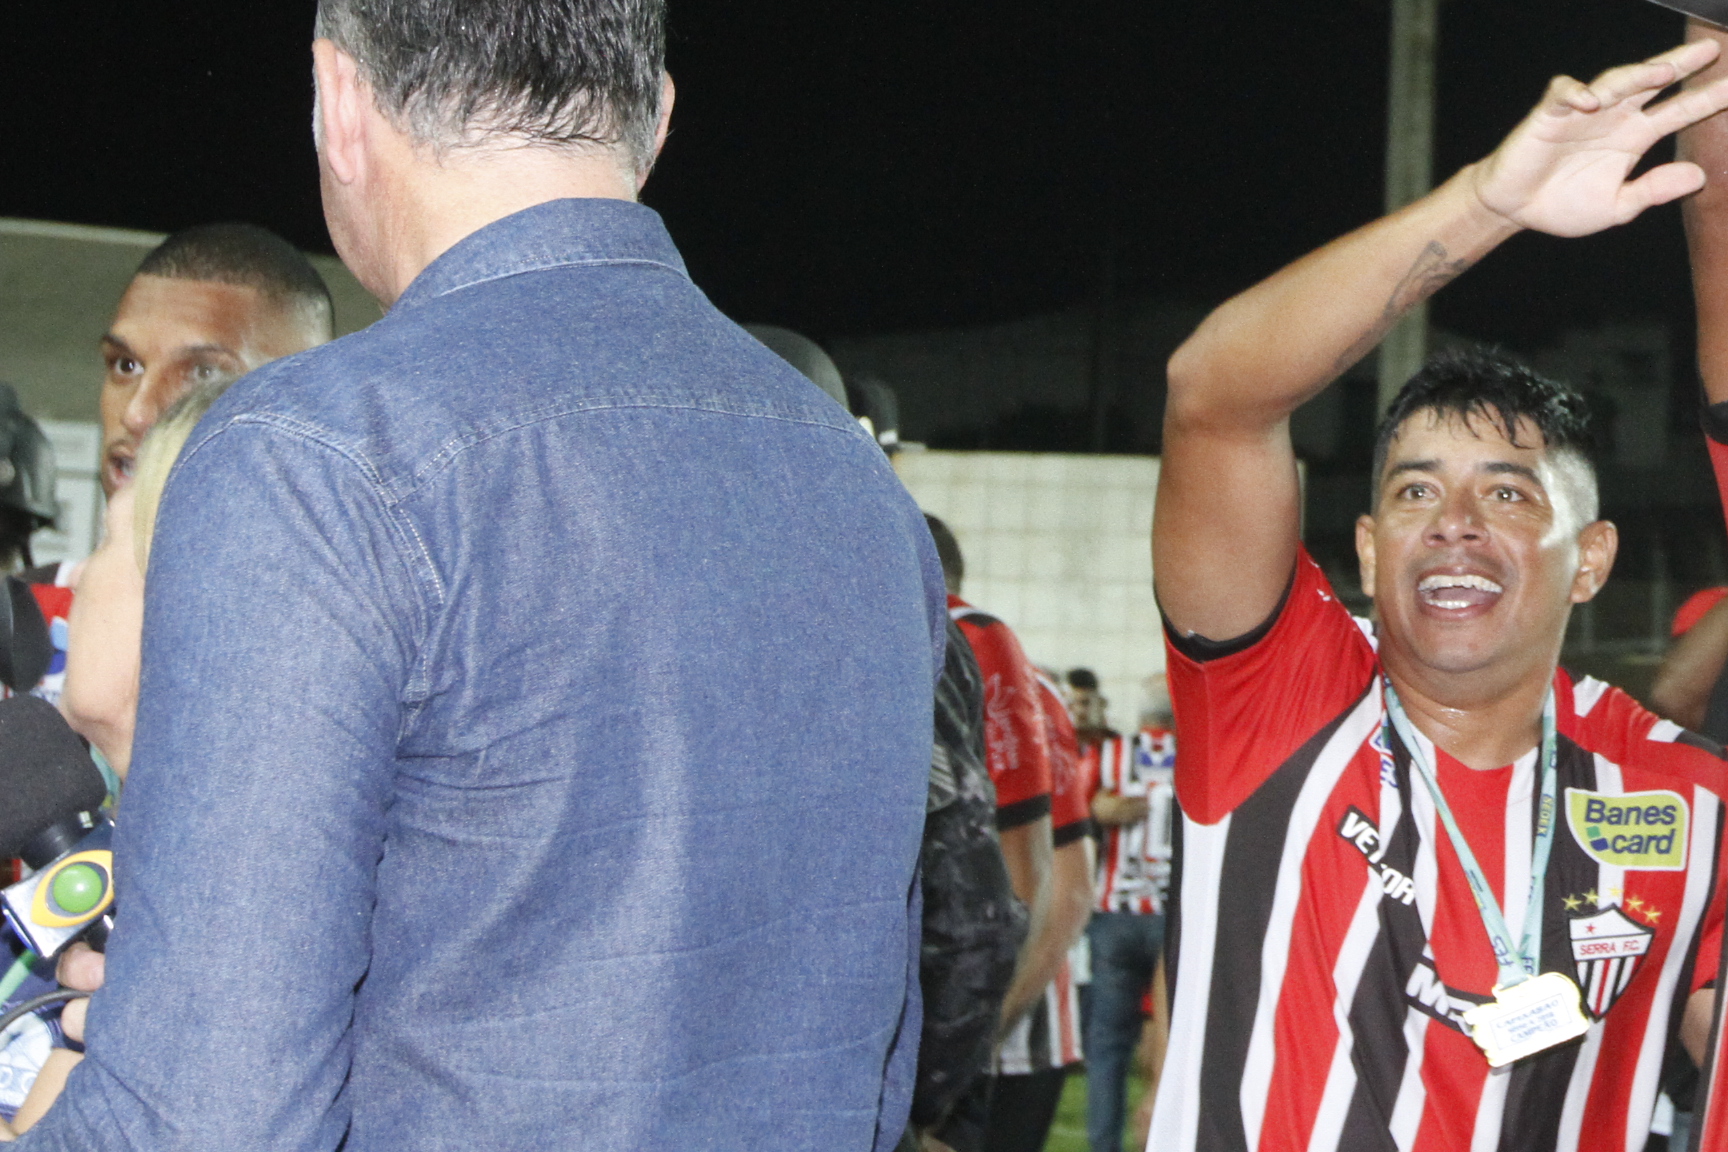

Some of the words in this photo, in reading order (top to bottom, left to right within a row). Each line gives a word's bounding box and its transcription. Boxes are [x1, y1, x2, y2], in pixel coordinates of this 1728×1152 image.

[1585, 799, 1677, 825] Banes
[1612, 828, 1676, 854] card
[1493, 935, 1514, 966] FES
[1580, 942, 1616, 955] SERRA
